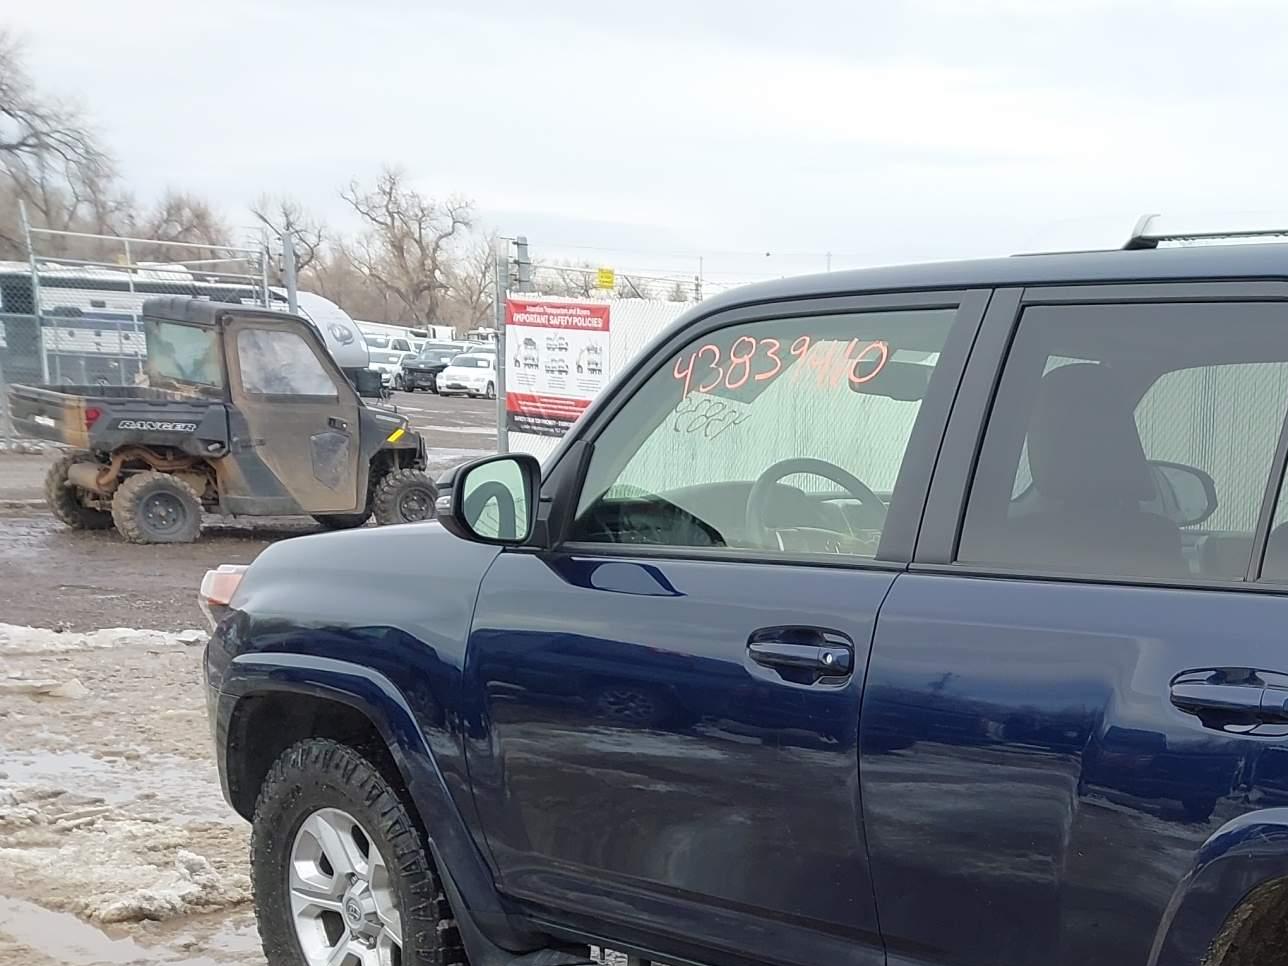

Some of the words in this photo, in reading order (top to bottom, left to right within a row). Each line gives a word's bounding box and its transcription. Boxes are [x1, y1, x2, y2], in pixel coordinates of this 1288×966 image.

[513, 313, 549, 325] IMPORTANT
[549, 315, 572, 326] SAFETY
[572, 317, 603, 328] POLICIES
[118, 420, 197, 431] RANGER
